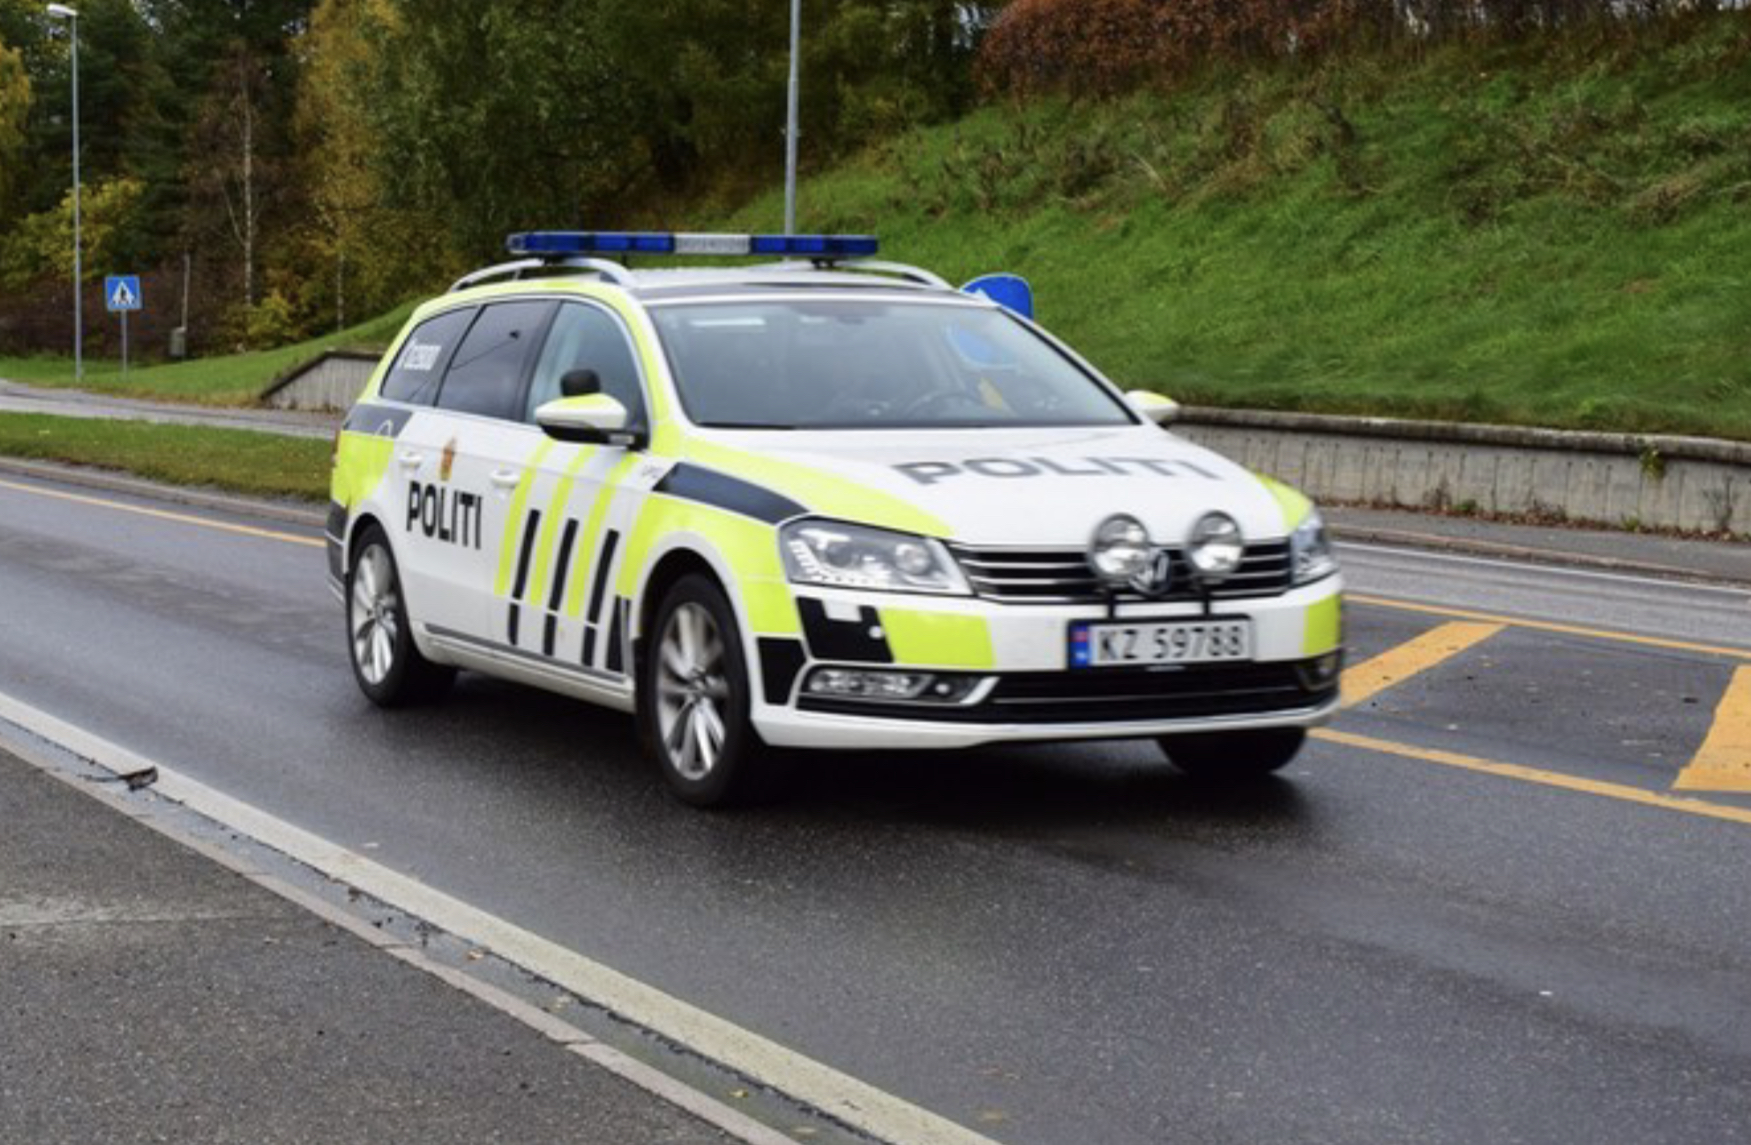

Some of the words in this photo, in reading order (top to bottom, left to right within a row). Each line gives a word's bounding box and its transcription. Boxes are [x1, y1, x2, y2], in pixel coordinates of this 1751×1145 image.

[890, 456, 1223, 485] POLITI
[406, 480, 482, 550] POLITI
[1100, 628, 1138, 660] KZ
[1152, 625, 1243, 659] 59788
